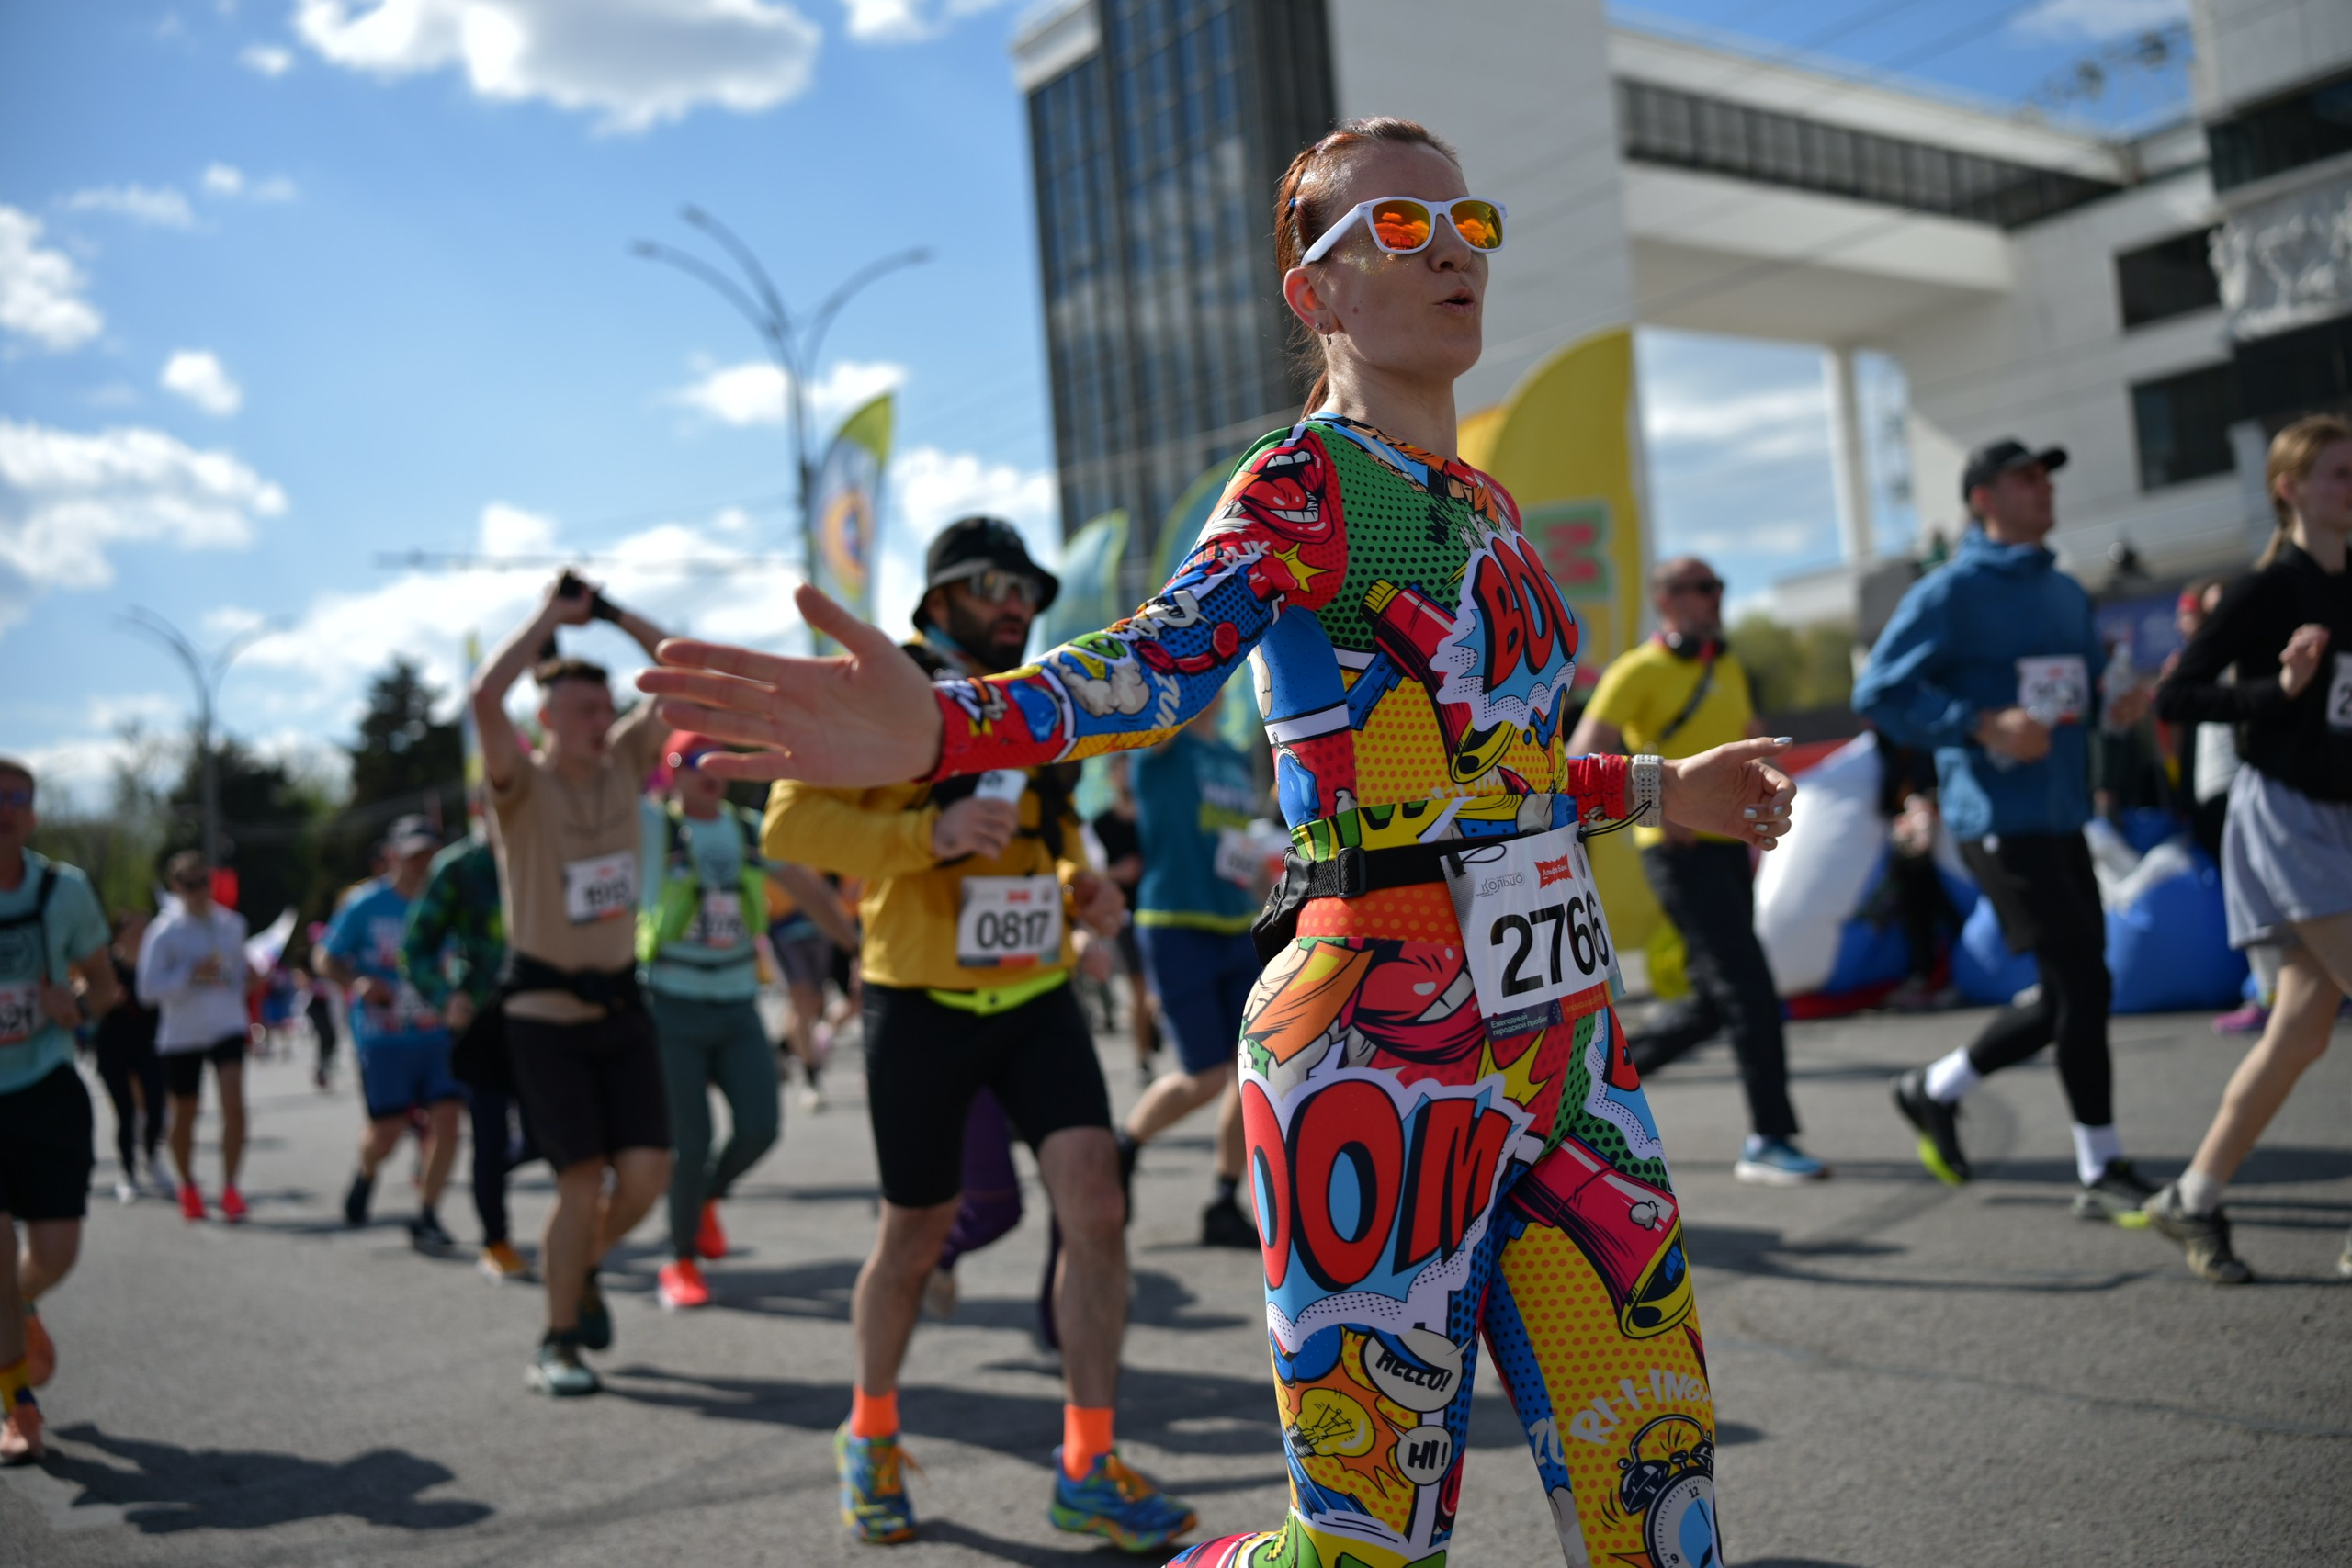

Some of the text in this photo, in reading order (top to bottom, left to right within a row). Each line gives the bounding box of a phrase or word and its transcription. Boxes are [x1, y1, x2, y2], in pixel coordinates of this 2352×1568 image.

[1543, 865, 1559, 877] Альфа
[977, 909, 1050, 950] 0817
[1490, 890, 1610, 998] 2766
[1490, 1012, 1528, 1029] Ежегодный
[1492, 1015, 1549, 1036] городской пробег
[1688, 1485, 1701, 1499] 12
[1670, 1553, 1679, 1564] 9
